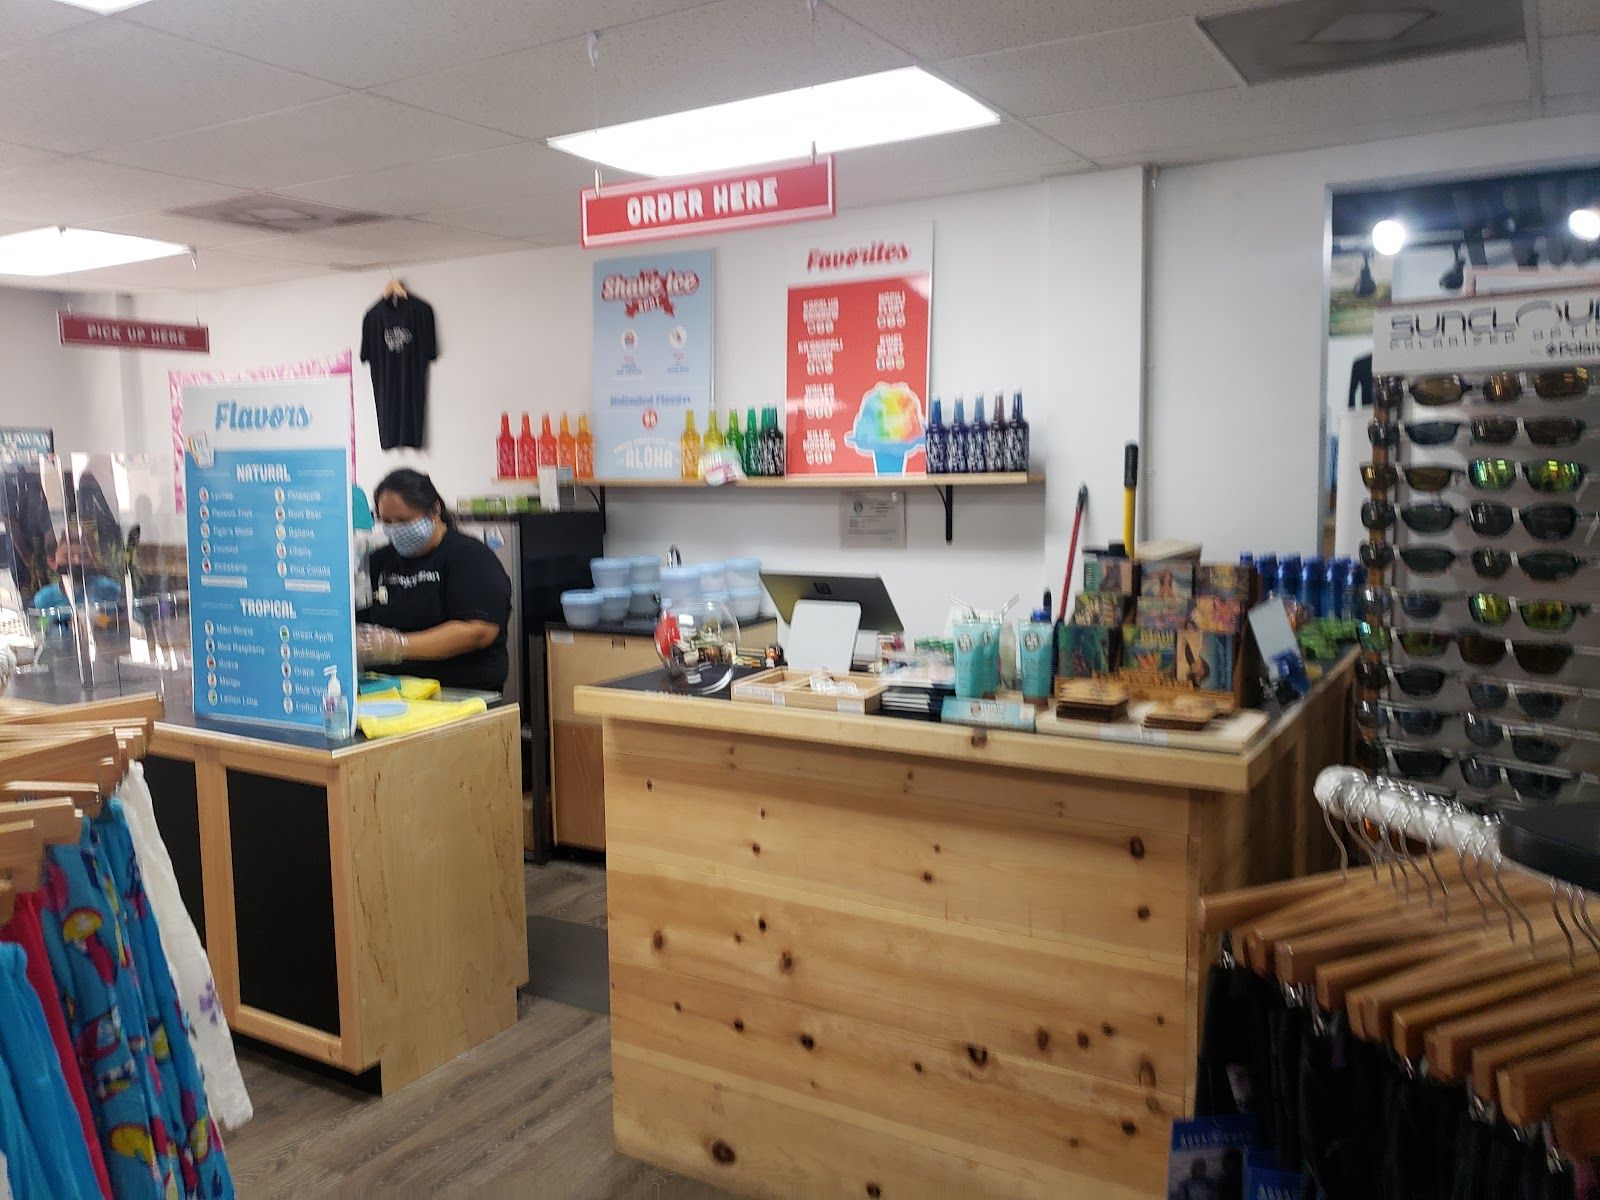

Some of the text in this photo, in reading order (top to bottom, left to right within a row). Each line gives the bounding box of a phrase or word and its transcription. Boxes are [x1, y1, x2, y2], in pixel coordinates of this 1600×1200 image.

[626, 176, 778, 227] ORDER HERE
[807, 240, 910, 272] Favorites
[602, 272, 661, 301] Shave
[87, 322, 187, 345] PICK UP HERE
[215, 399, 312, 432] Flavors
[626, 446, 673, 469] ALOHA
[236, 463, 292, 483] NATURAL
[240, 598, 297, 619] TROPICAL
